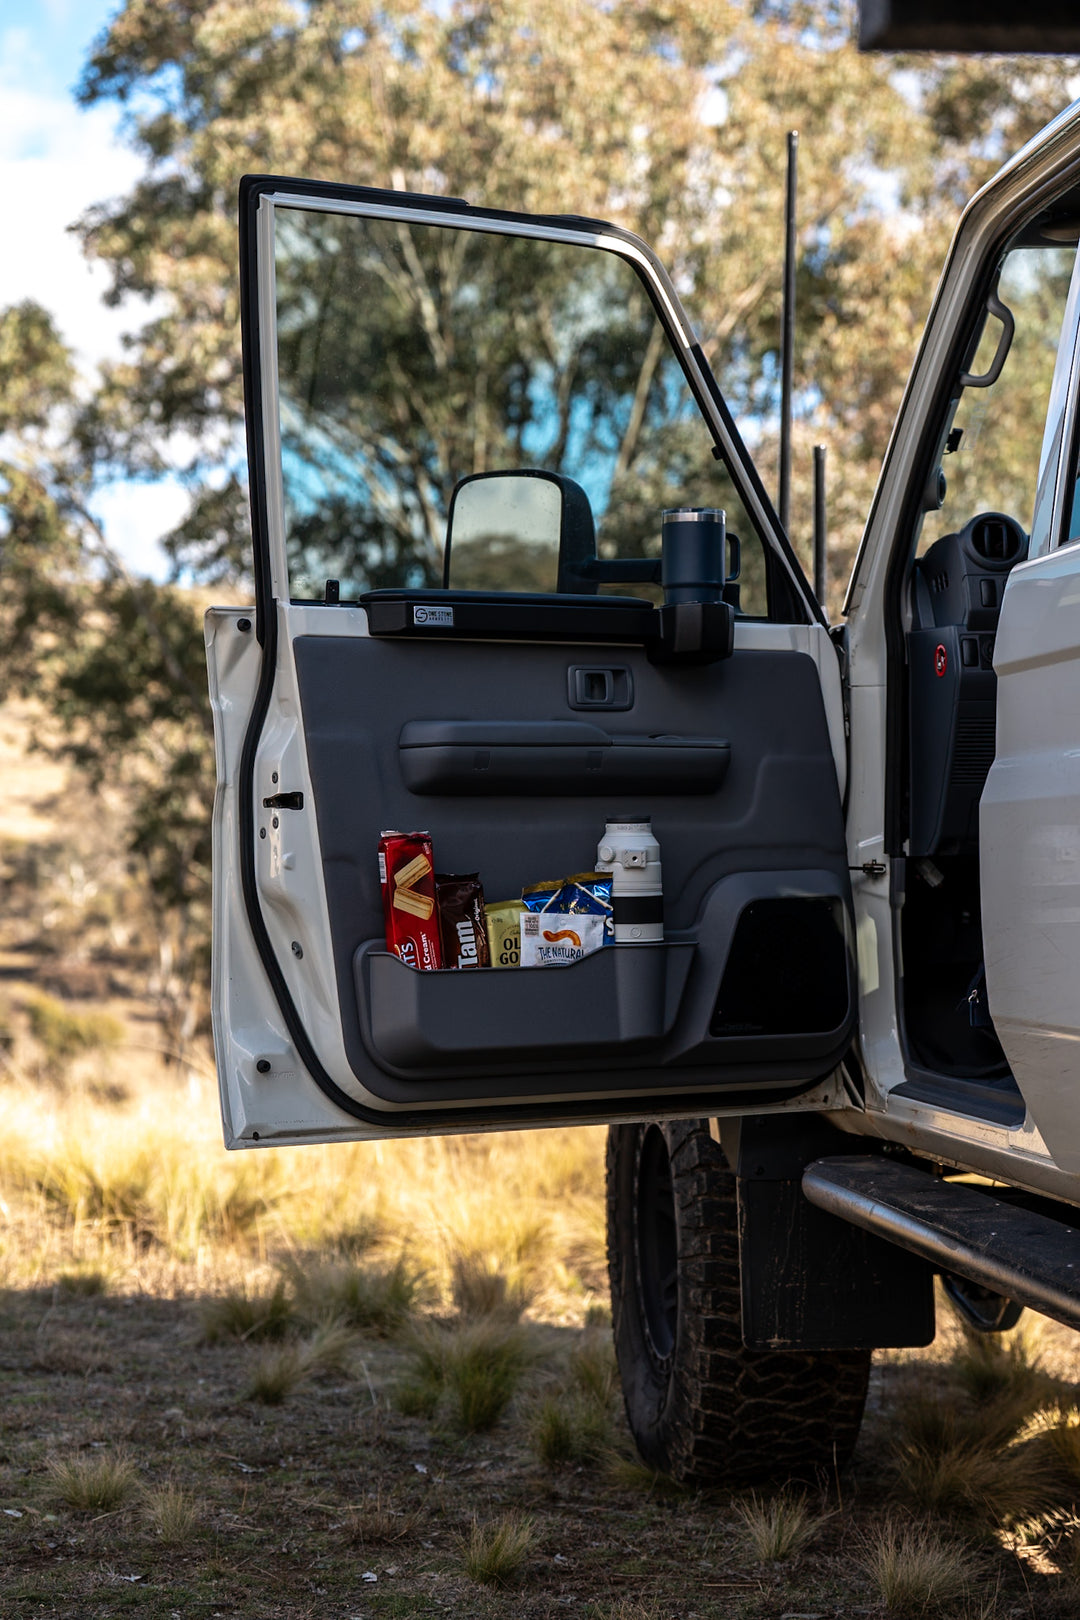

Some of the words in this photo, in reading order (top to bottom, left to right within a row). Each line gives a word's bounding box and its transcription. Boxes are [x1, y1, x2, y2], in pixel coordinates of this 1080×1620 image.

[421, 933, 430, 964] Cream
[456, 921, 478, 969] Tam
[503, 937, 521, 951] OL
[538, 946, 552, 960] THE
